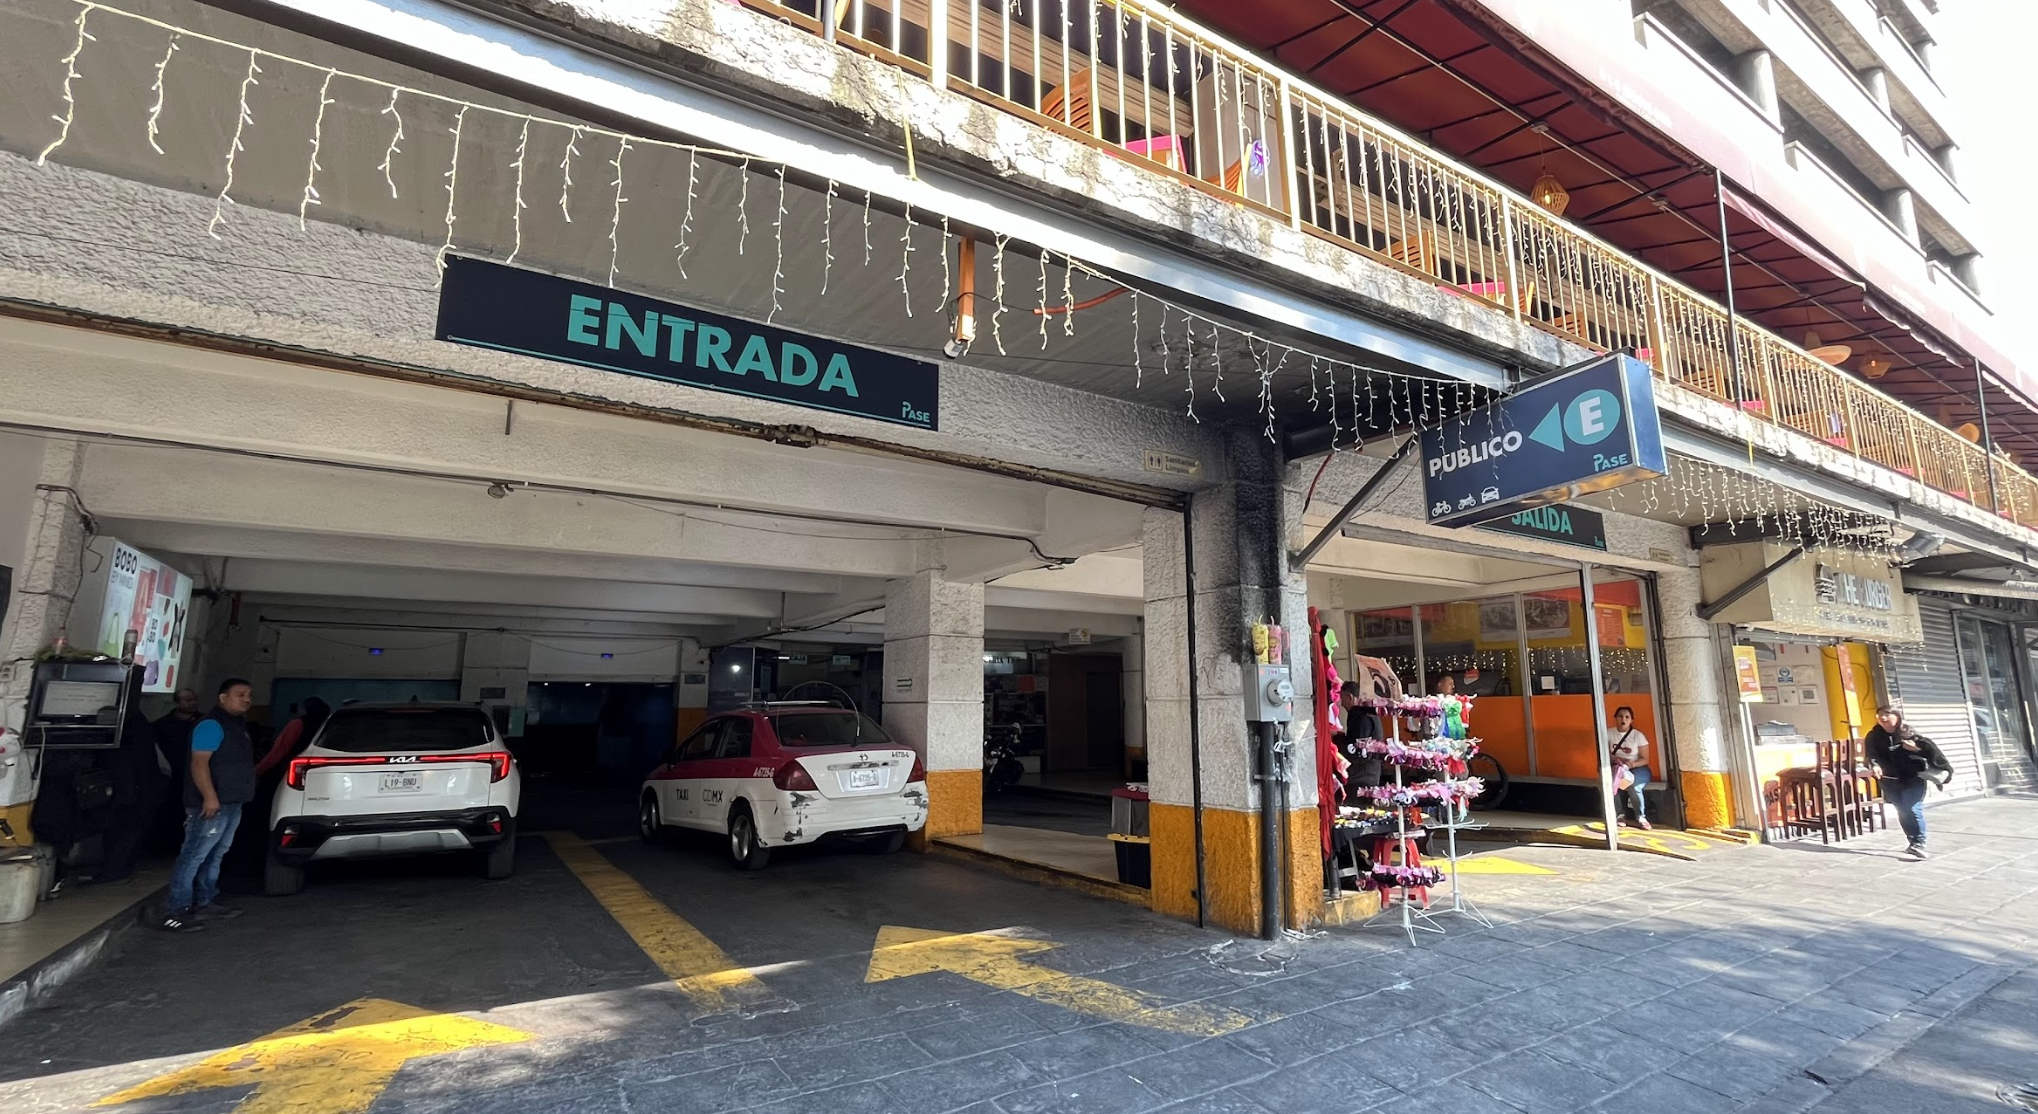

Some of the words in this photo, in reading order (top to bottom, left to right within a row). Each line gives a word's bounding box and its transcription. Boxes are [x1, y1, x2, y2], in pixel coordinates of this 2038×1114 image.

[567, 294, 860, 398] ENTRADA
[901, 400, 931, 424] PASE
[1579, 396, 1604, 436] E
[1593, 453, 1628, 473] PASE
[115, 548, 137, 574] BOBO
[676, 789, 689, 801] TAXI
[702, 789, 724, 803] CDMX
